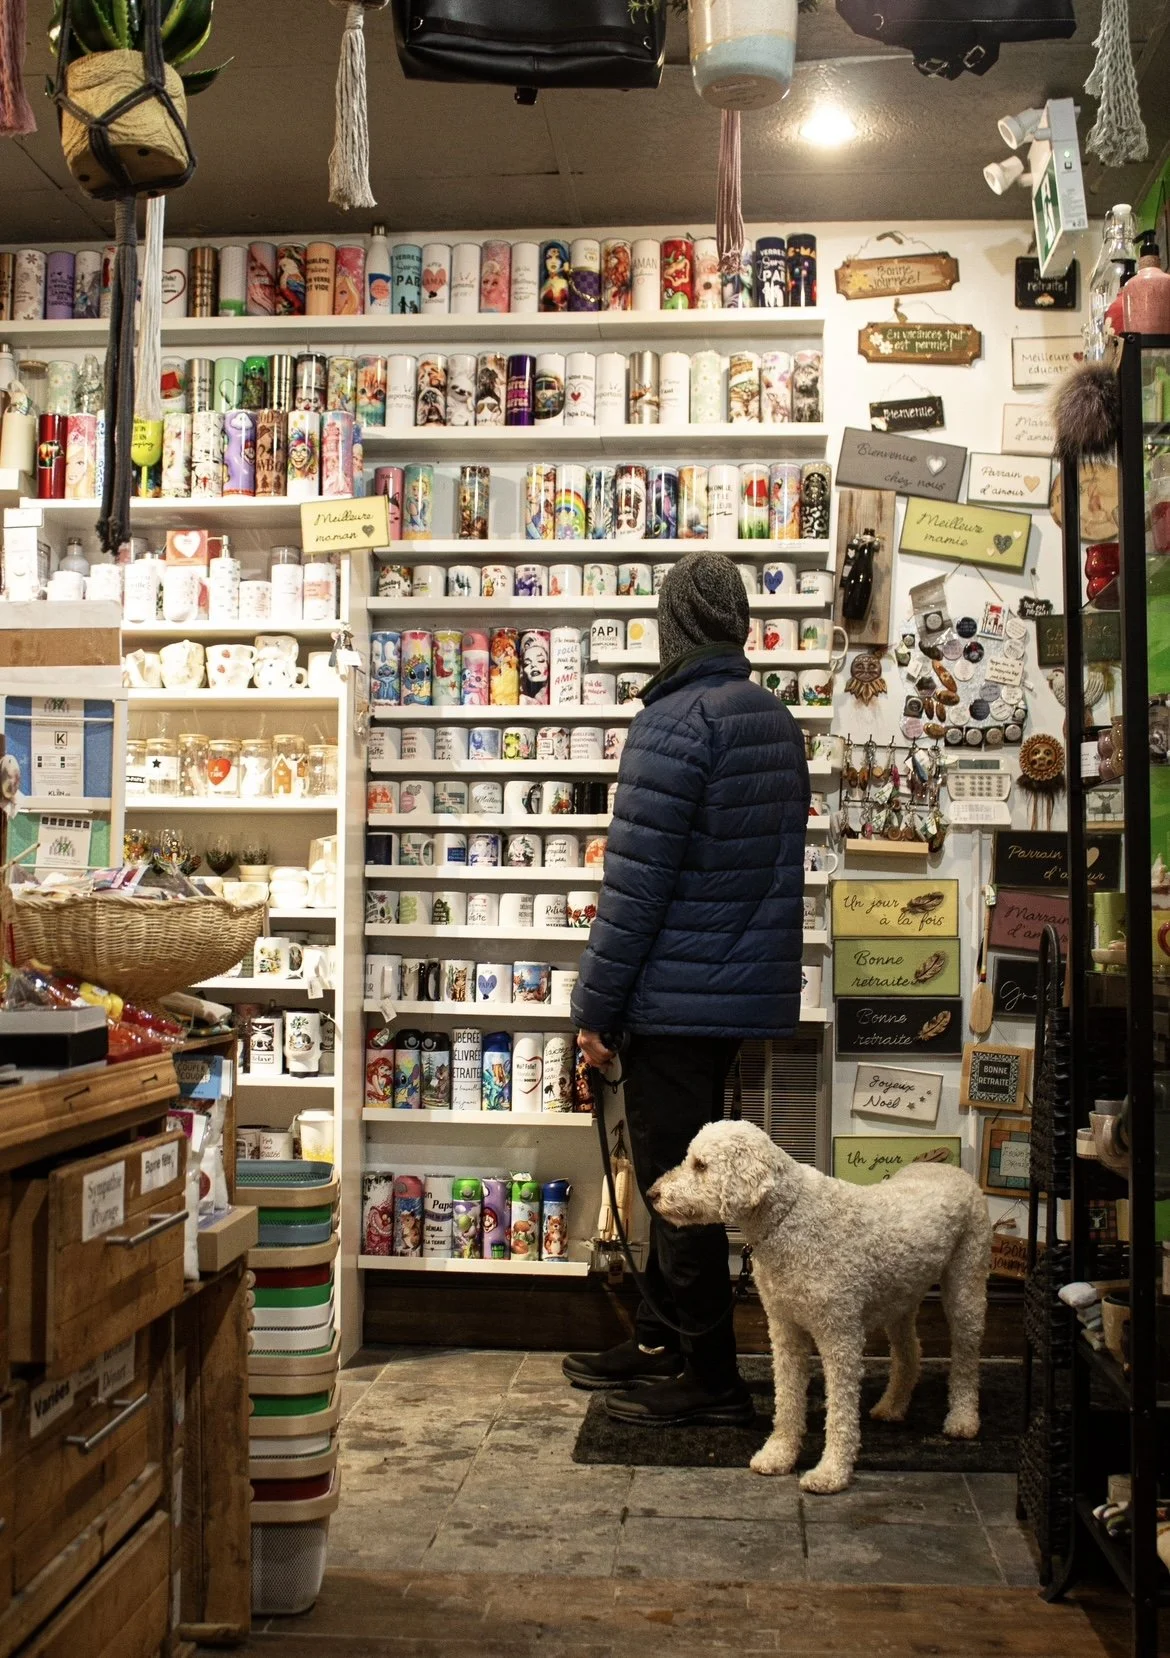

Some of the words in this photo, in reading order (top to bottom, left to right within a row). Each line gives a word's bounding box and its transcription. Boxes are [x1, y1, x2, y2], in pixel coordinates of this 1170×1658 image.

[877, 262, 914, 277] Bonne
[857, 441, 918, 463] Bienvenue
[981, 466, 1023, 479] Parrain
[916, 478, 947, 492] nous
[979, 481, 1025, 497] d'amour
[314, 510, 374, 526] Meilleure
[315, 531, 358, 543] maman
[923, 532, 968, 547] mamie
[56, 733, 65, 744] K
[1008, 844, 1066, 861] Parrain
[843, 894, 865, 908] Un
[865, 897, 900, 915] jour
[896, 910, 914, 926] la
[919, 914, 944, 932] fois
[1004, 904, 1070, 925] Marrain
[853, 949, 905, 967] Bonne
[851, 974, 912, 989] retraite
[856, 1006, 909, 1025] Bonne
[853, 1031, 916, 1047] retraite
[983, 1065, 1009, 1076] BONNE
[868, 1074, 915, 1094] Joyeux
[978, 1076, 1011, 1087] RETRAITE
[862, 1094, 902, 1110] Noël
[847, 1152, 866, 1165] Un
[867, 1154, 903, 1172] jour
